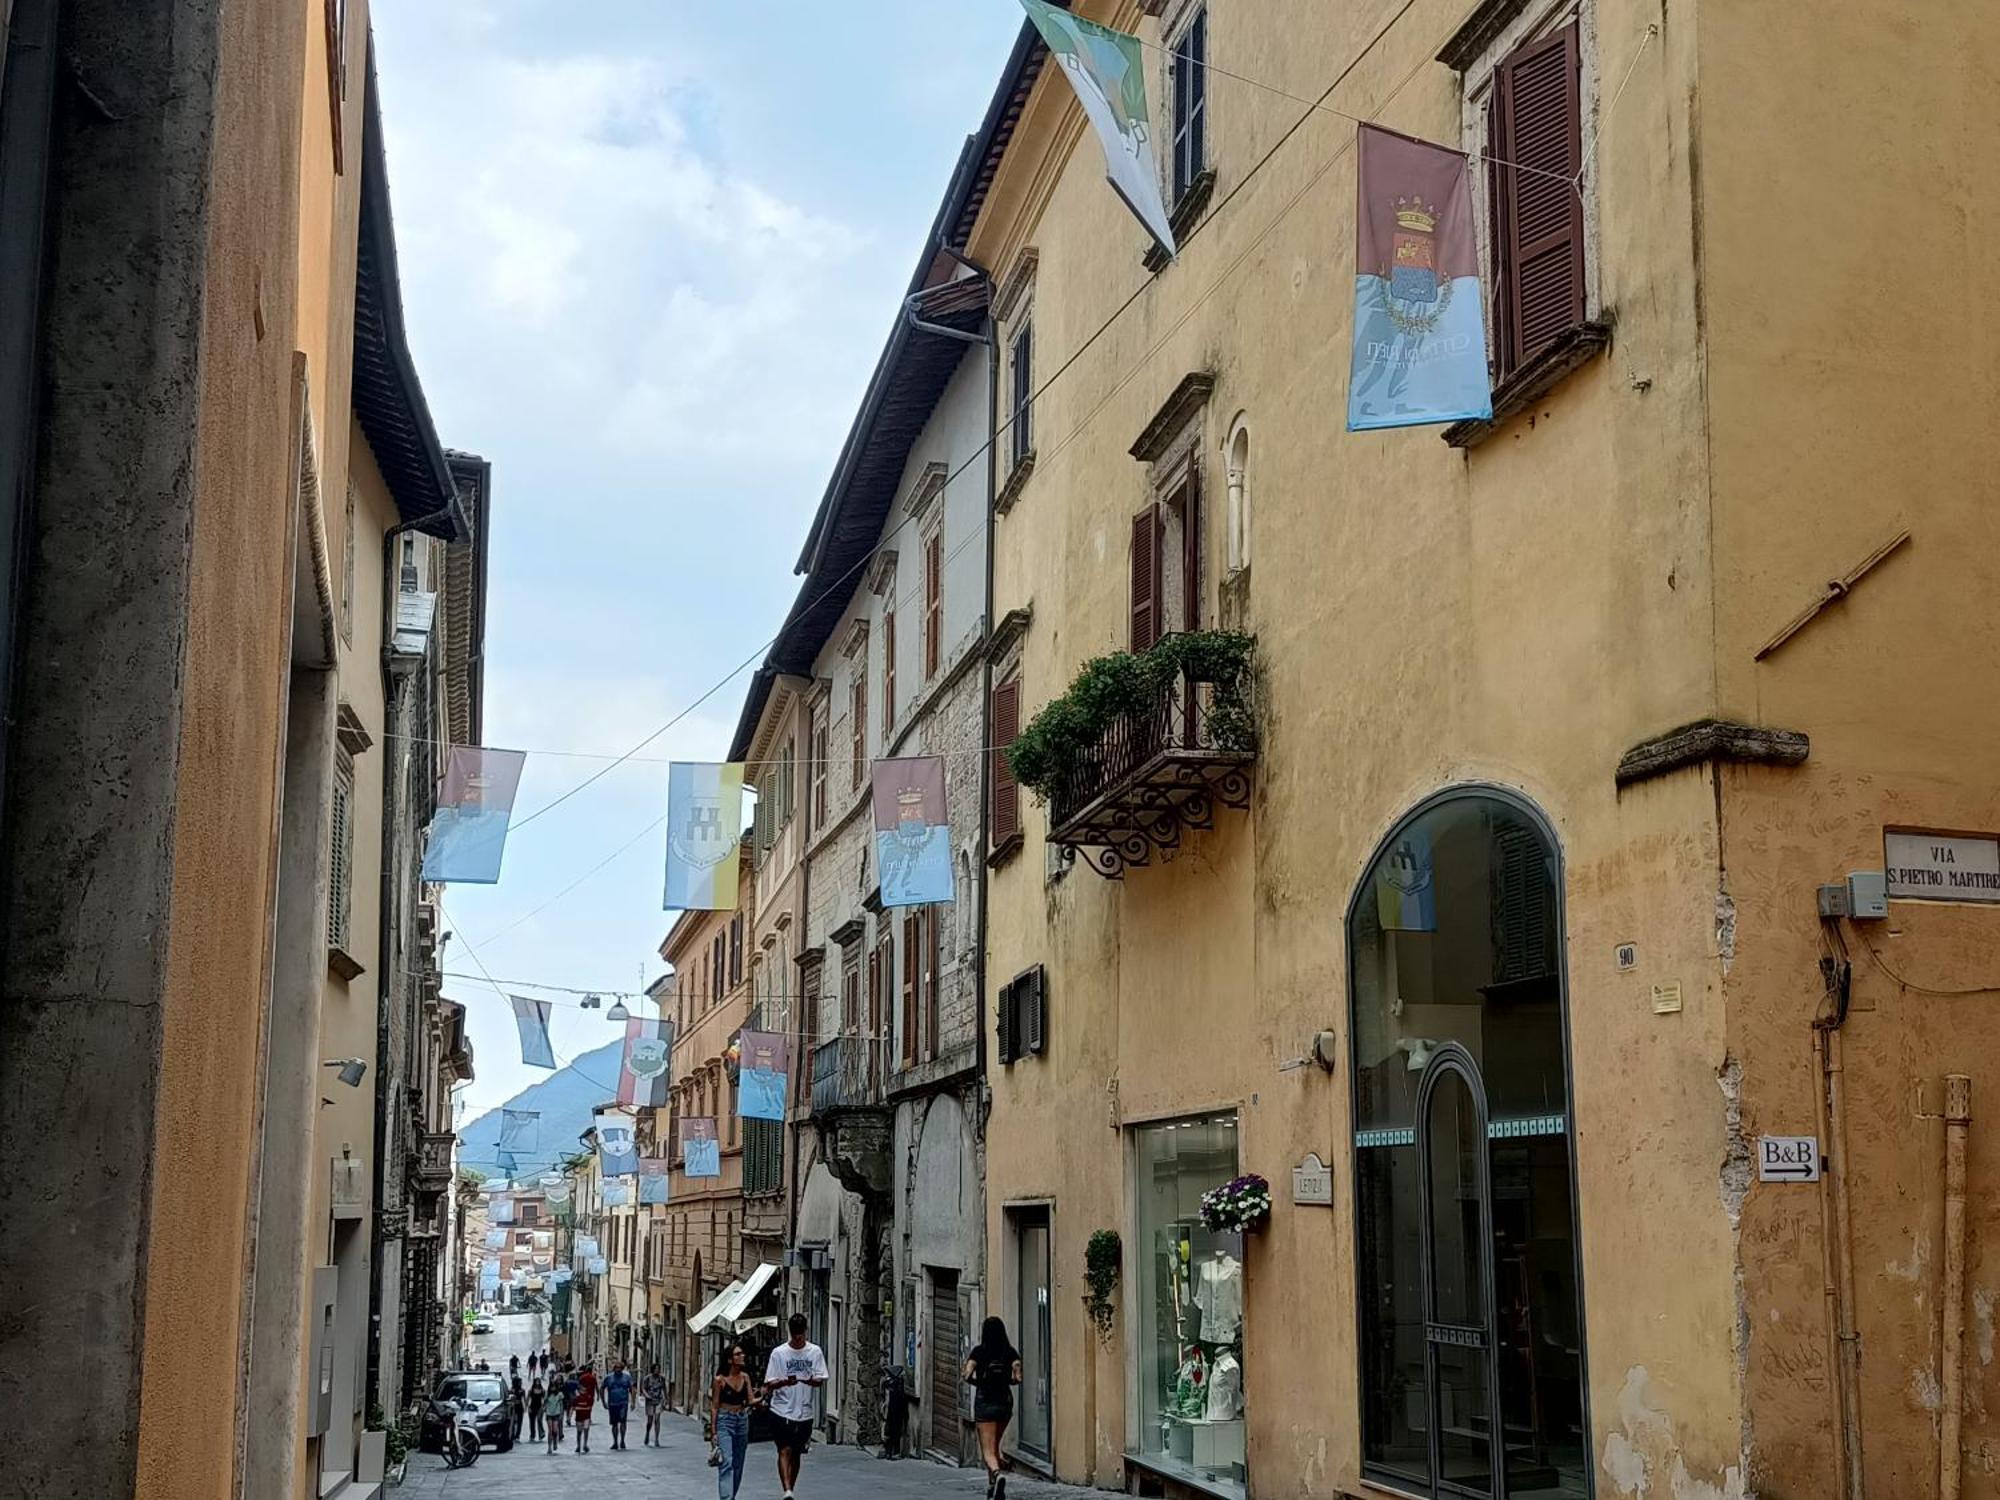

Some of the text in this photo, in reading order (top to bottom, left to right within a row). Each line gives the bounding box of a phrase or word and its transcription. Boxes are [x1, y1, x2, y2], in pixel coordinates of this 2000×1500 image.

[1930, 846, 1955, 863] VIA
[1949, 871, 2000, 889] MARTIRE
[1619, 947, 1634, 966] 90
[1765, 1141, 1812, 1164] B&B
